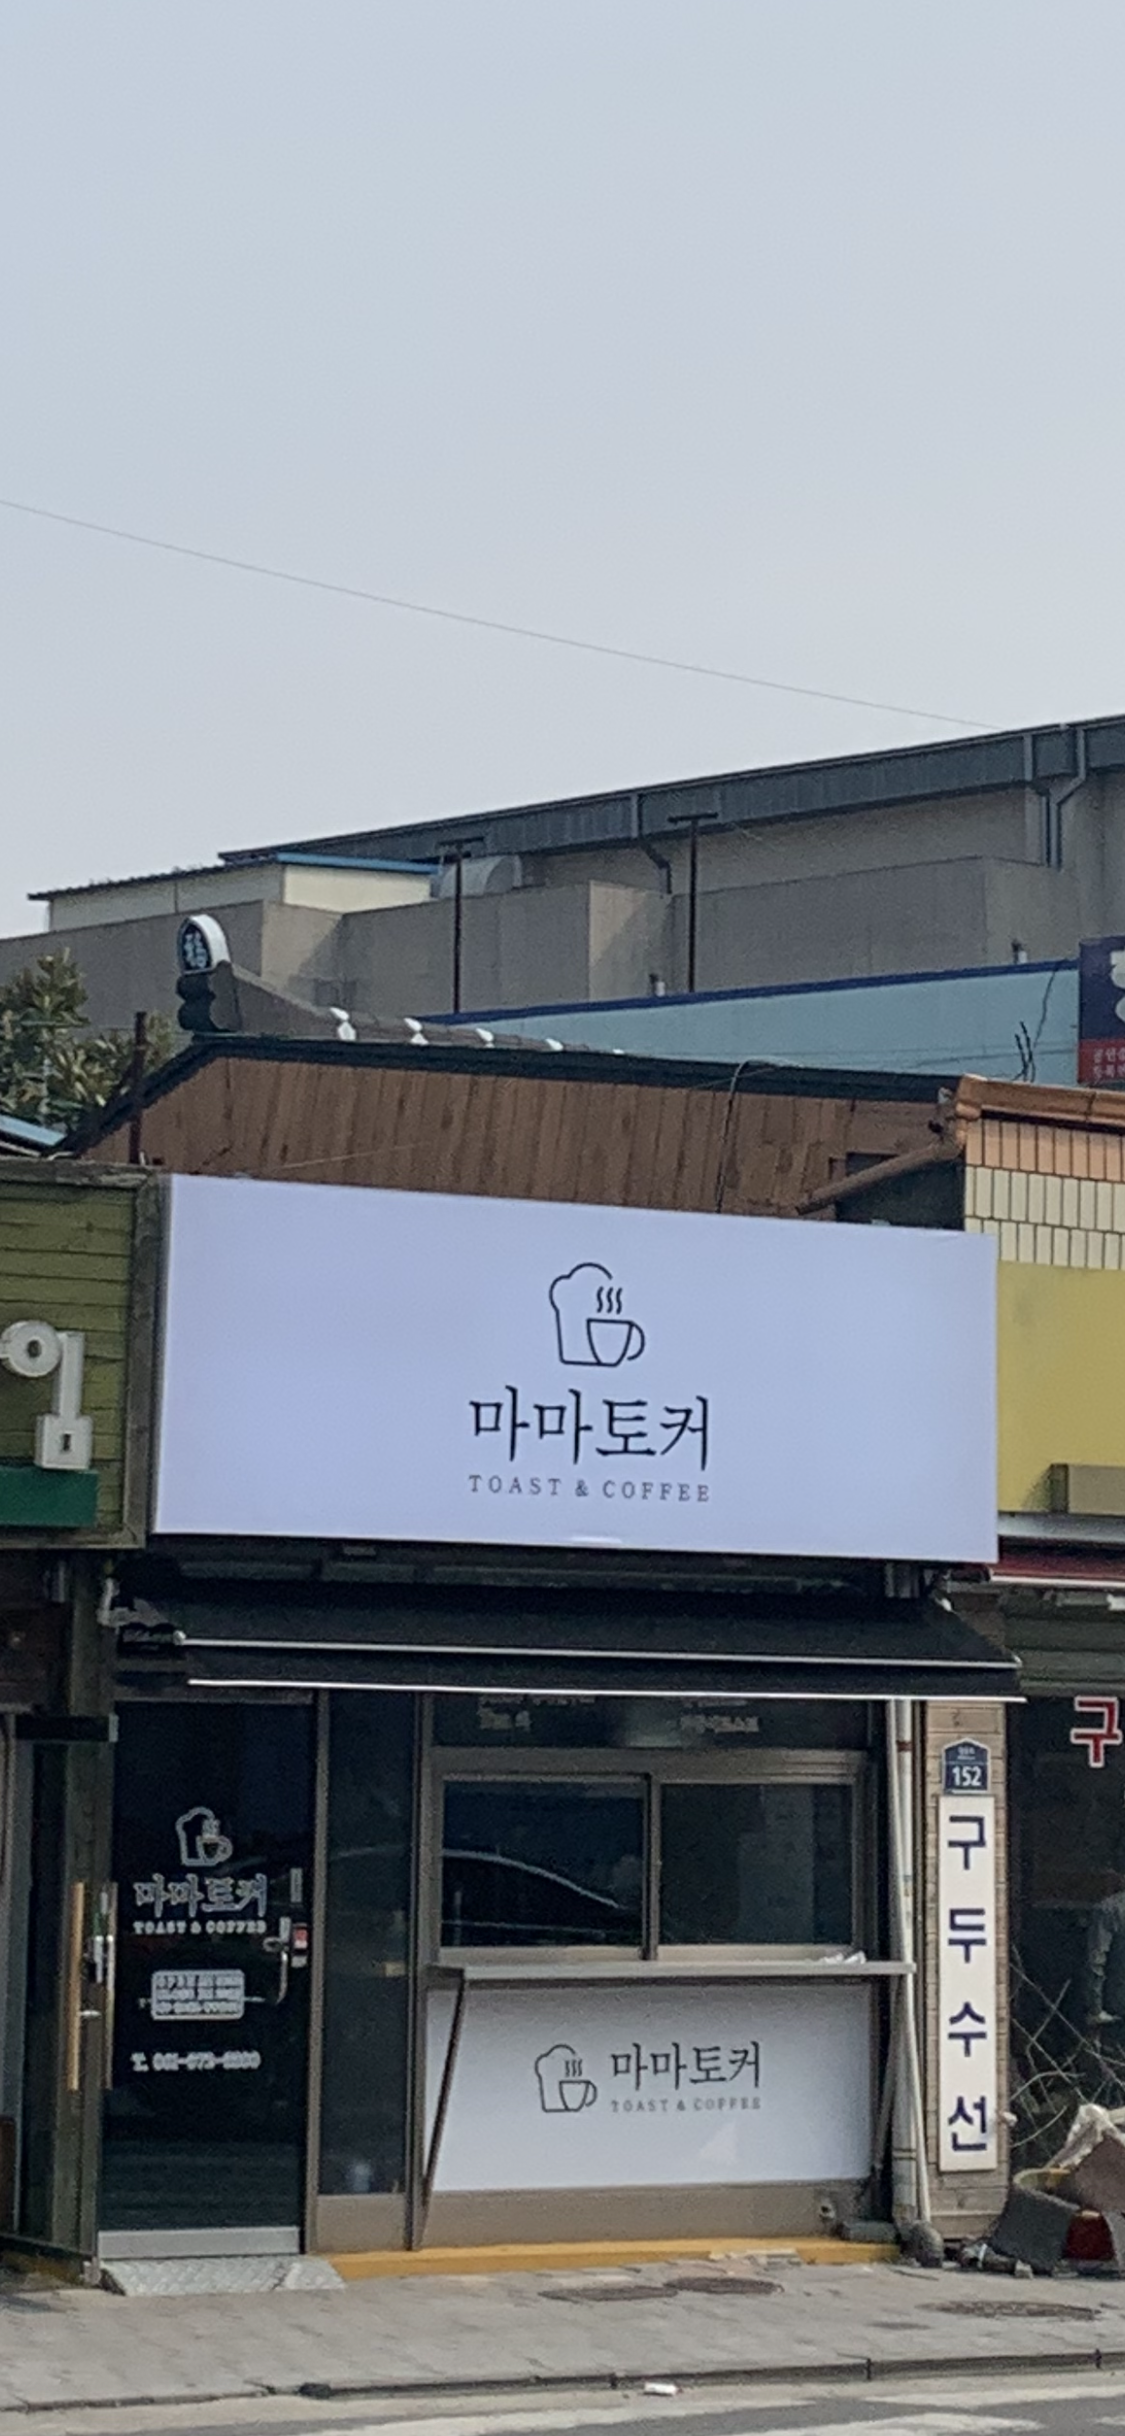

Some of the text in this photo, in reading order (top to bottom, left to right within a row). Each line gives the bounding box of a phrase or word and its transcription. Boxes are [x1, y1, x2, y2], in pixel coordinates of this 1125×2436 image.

[469, 1384, 709, 1472] 마마토커
[468, 1474, 709, 1502] TOAST & COFFEE
[952, 1766, 982, 1786] 152
[133, 1873, 267, 1918] 마마토커
[133, 1920, 187, 1935] TOAST
[205, 1920, 267, 1935] COFFEE
[947, 1815, 988, 2153] 구두수선
[611, 2041, 760, 2091] 마마토커
[611, 2097, 761, 2112] TOAST & COFFEE
